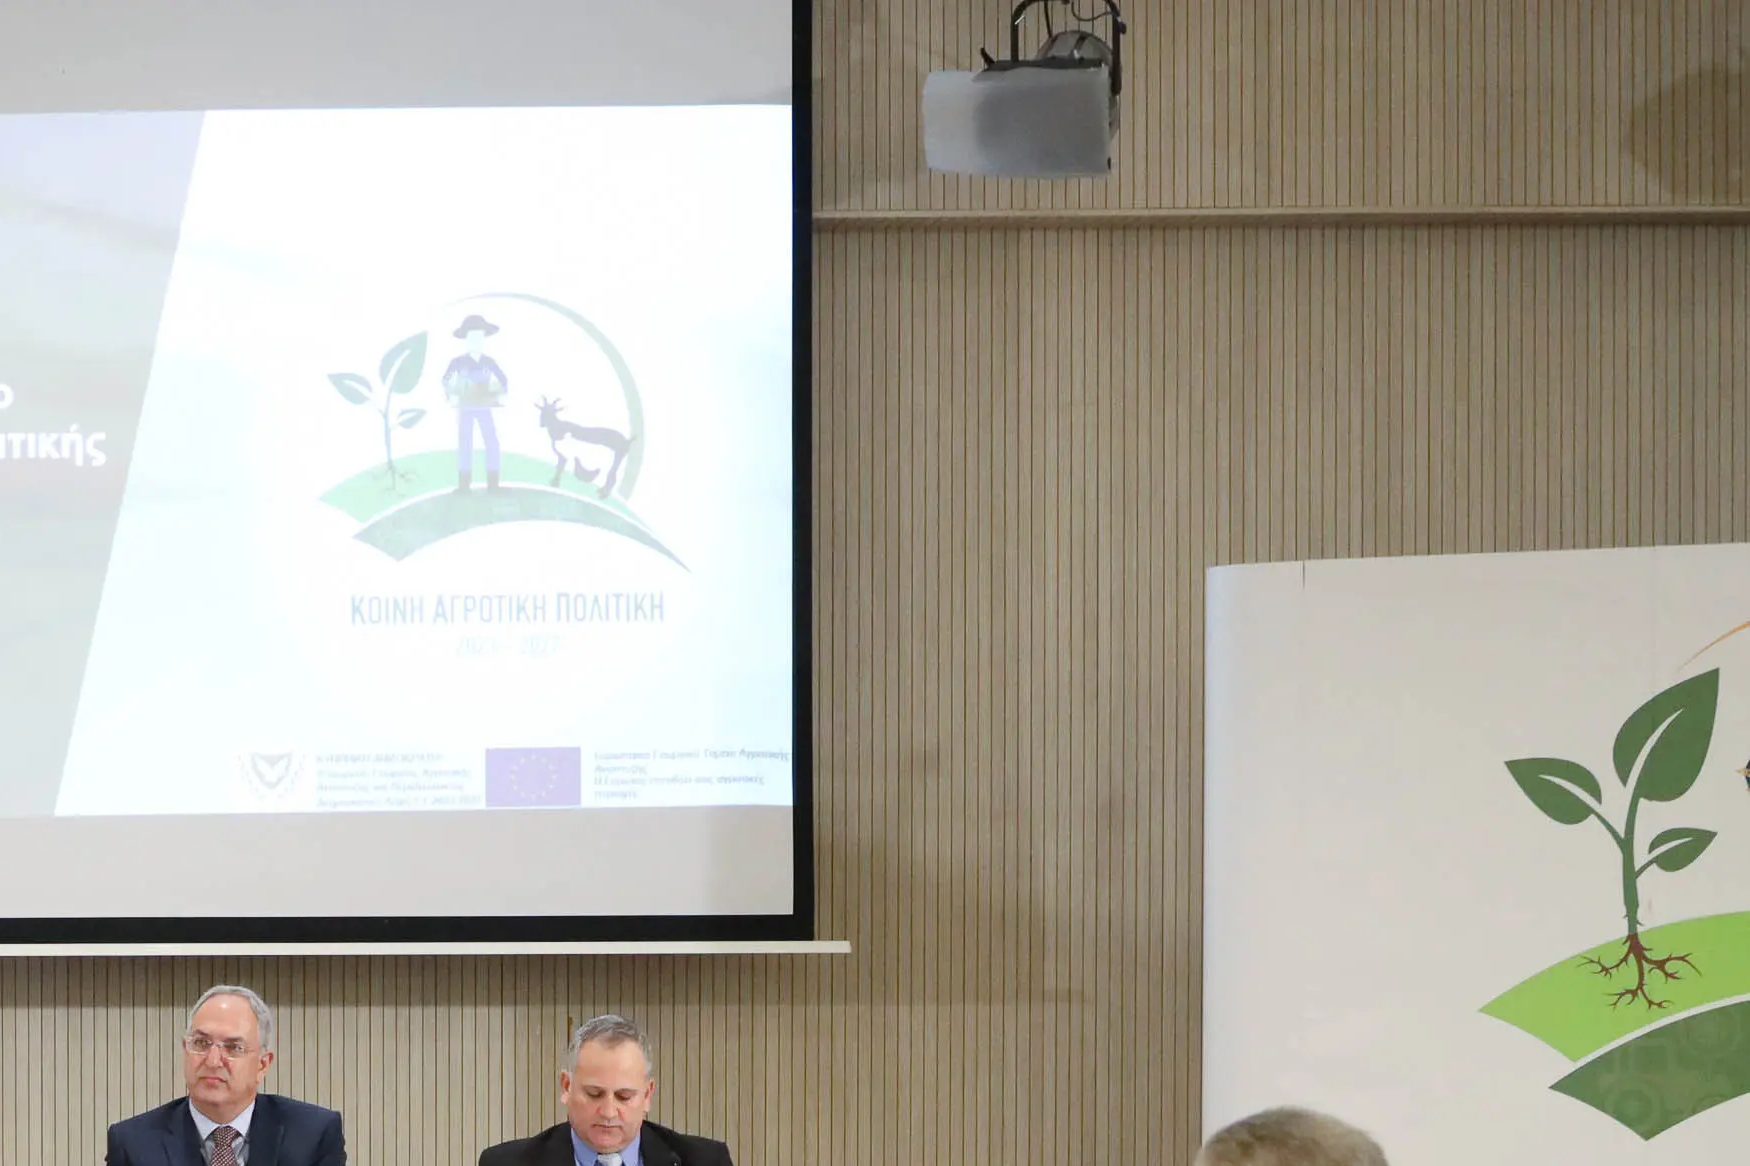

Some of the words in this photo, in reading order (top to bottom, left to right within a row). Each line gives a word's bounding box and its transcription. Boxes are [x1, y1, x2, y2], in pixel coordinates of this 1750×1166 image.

[351, 595, 425, 625] ΚΟΙΝΗ
[433, 594, 547, 624] ΑΓΡΟΤΙΚΗ
[556, 591, 665, 623] ΠΟΛΙΤΙΚΗ
